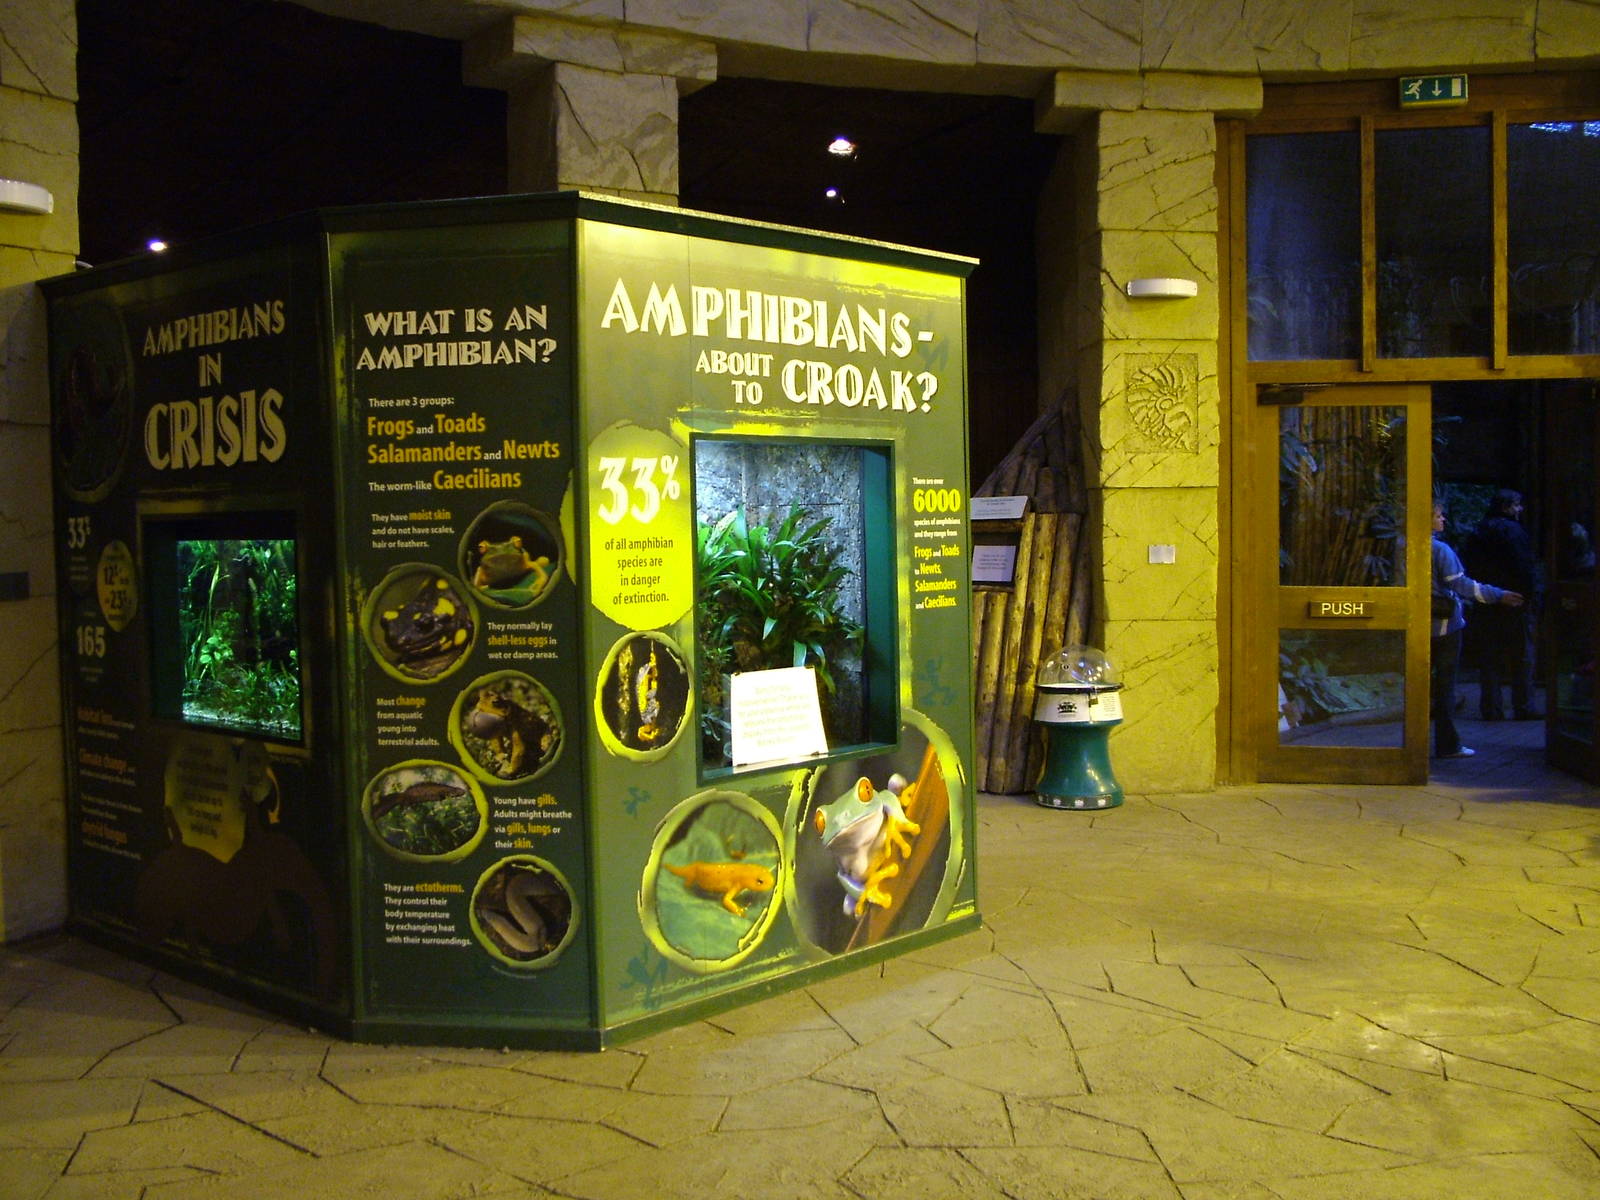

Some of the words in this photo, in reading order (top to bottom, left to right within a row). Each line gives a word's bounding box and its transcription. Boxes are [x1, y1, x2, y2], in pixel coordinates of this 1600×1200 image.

[364, 310, 454, 336] WHAT
[465, 308, 493, 333] IS
[504, 305, 547, 331] AN
[143, 300, 285, 357] AMPHIBIANS
[356, 338, 557, 371] AMPHIBIAN?
[199, 352, 222, 387] IN
[696, 350, 774, 377] ABOUT
[731, 379, 763, 405] TO
[781, 359, 938, 413] CROAK?
[368, 398, 395, 408] There
[395, 398, 411, 407] are
[412, 397, 418, 406] 3
[419, 397, 455, 408] groups:
[144, 388, 286, 470] CRISIS
[367, 416, 414, 440] Frogs
[416, 425, 434, 434] and
[434, 412, 486, 434] Toads
[367, 442, 482, 464] Salamanders
[483, 450, 502, 460] and
[503, 440, 560, 459] Newts
[368, 482, 386, 492] The
[387, 480, 432, 492] worm-like
[433, 468, 522, 490] Caecilians
[598, 455, 681, 525] 33%
[913, 488, 961, 513] 6000
[371, 513, 389, 523] They
[390, 513, 409, 522] have
[372, 527, 386, 535] and
[387, 527, 398, 535] do
[398, 527, 411, 535] not
[412, 526, 430, 534] have
[372, 540, 387, 549] hair
[605, 538, 614, 550] of
[616, 538, 627, 550] all
[628, 537, 674, 551] amphibian
[914, 545, 932, 560] Frogs
[932, 549, 941, 557] and
[941, 544, 960, 556] Toads
[617, 556, 648, 570] species
[649, 557, 663, 568] are
[620, 574, 629, 586] in
[631, 573, 661, 588] danger
[915, 578, 957, 592] Salamanders
[613, 593, 622, 605] of
[623, 592, 670, 604] extinction.
[915, 601, 924, 609] and
[1321, 602, 1364, 615] PUSH
[487, 622, 506, 631] They
[507, 621, 540, 631] normally
[541, 621, 553, 631] lay
[76, 626, 106, 658] 165
[528, 636, 548, 648] eggs
[549, 636, 557, 645] in
[513, 651, 535, 660] damp
[377, 711, 394, 719] from
[395, 711, 424, 720] aquatic
[377, 725, 401, 734] young
[493, 797, 517, 806] Young
[518, 797, 536, 805] have
[493, 810, 518, 818] Adults
[519, 810, 541, 820] might
[543, 810, 572, 818] breathe
[494, 825, 506, 833] via
[528, 823, 551, 836] lungs
[495, 839, 512, 848] their
[384, 883, 401, 893] They
[384, 897, 402, 906] They
[403, 897, 429, 905] control
[430, 897, 448, 905] their
[385, 910, 403, 919] body
[404, 910, 450, 919] temperature
[385, 923, 394, 932] by
[396, 923, 437, 933] exchanging
[438, 924, 455, 932] heat
[403, 936, 420, 944] their
